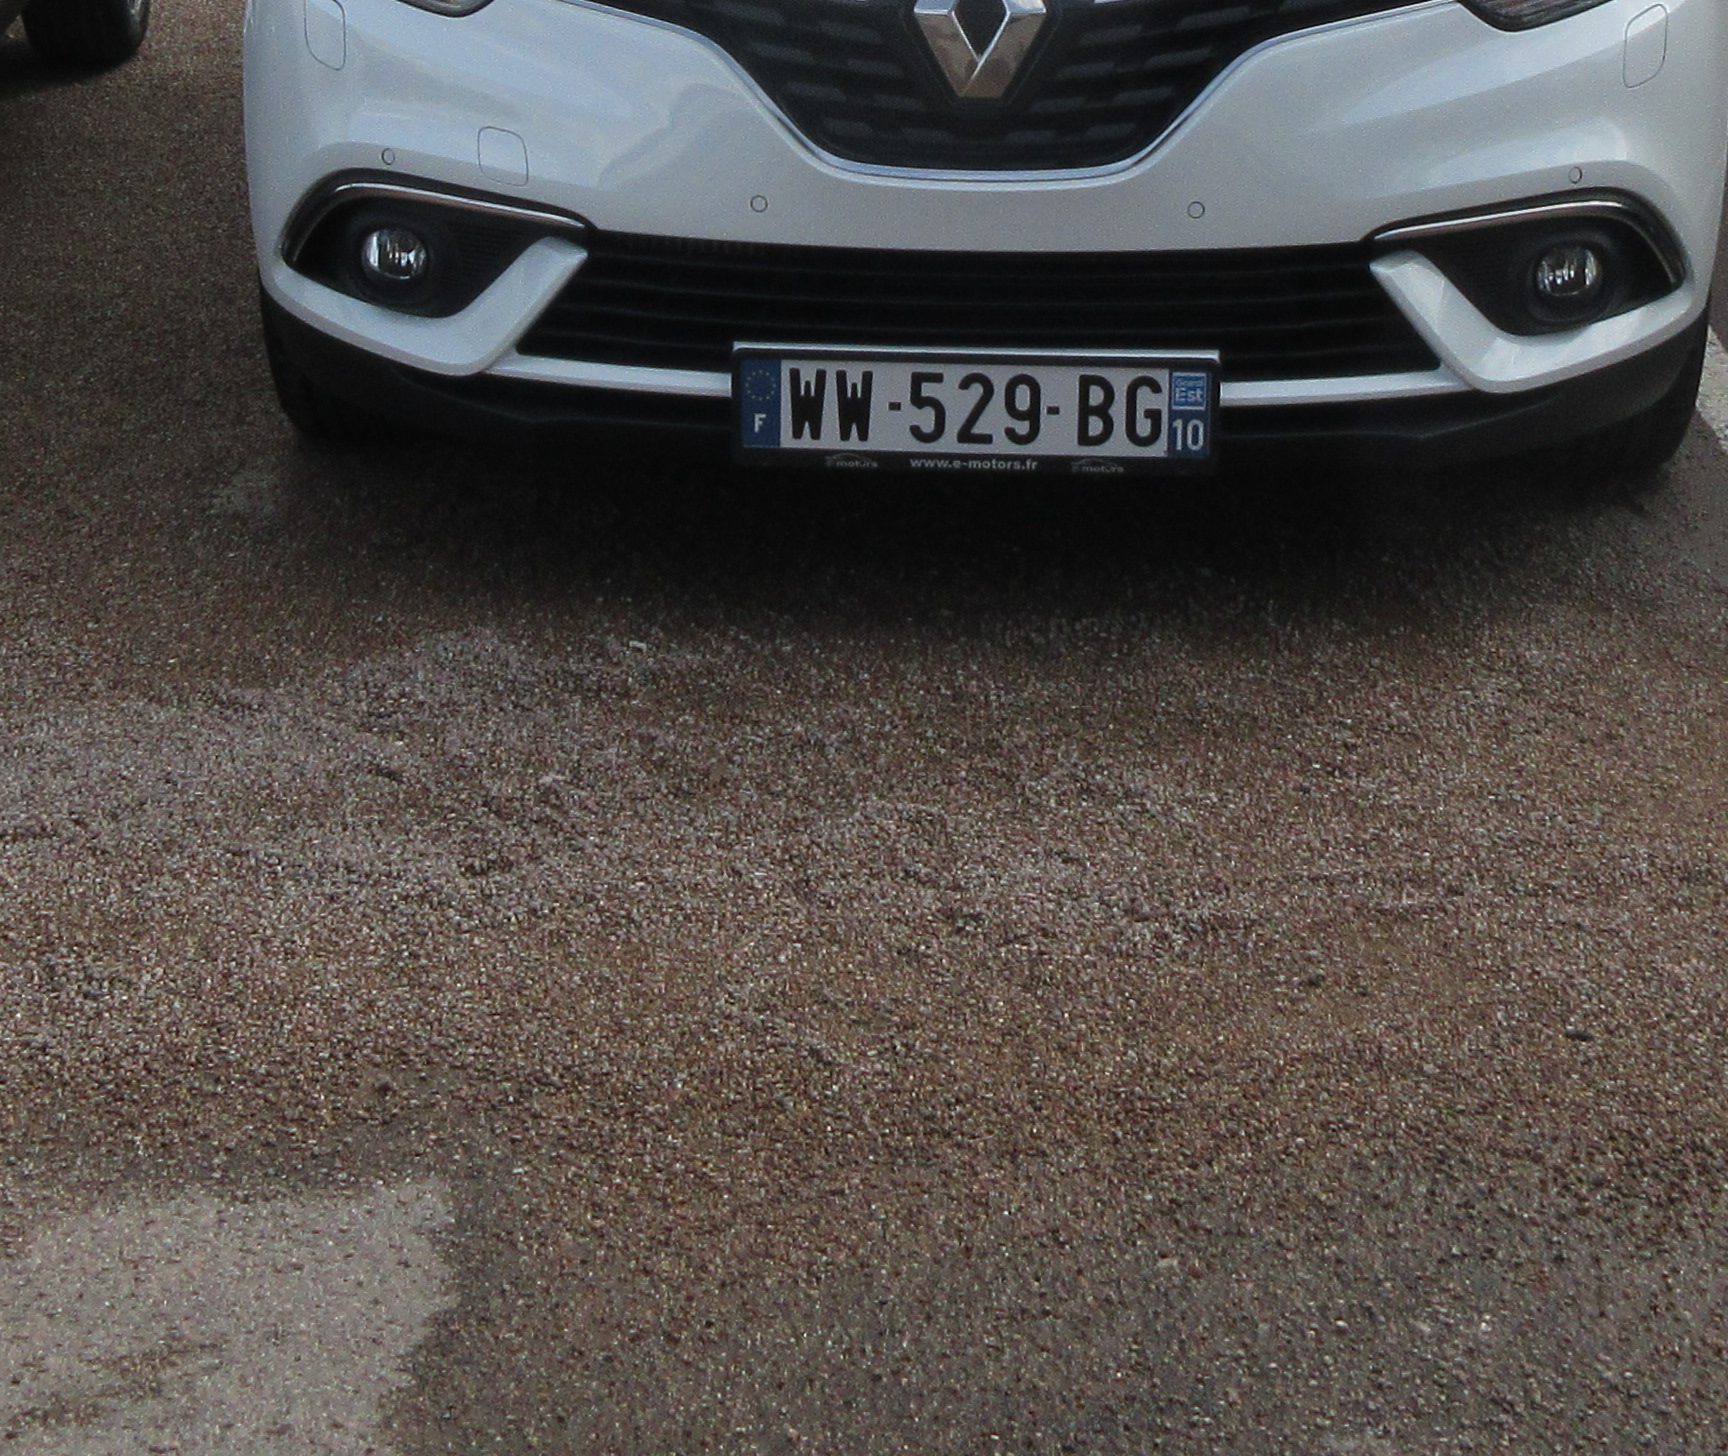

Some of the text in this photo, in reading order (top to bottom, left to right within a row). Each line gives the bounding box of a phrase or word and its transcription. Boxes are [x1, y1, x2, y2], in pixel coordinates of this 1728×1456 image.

[1175, 387, 1204, 402] Est
[753, 367, 1164, 447] F WW-529-BG
[1172, 418, 1204, 451] 10
[909, 458, 1039, 470] www.e-motors.fr
